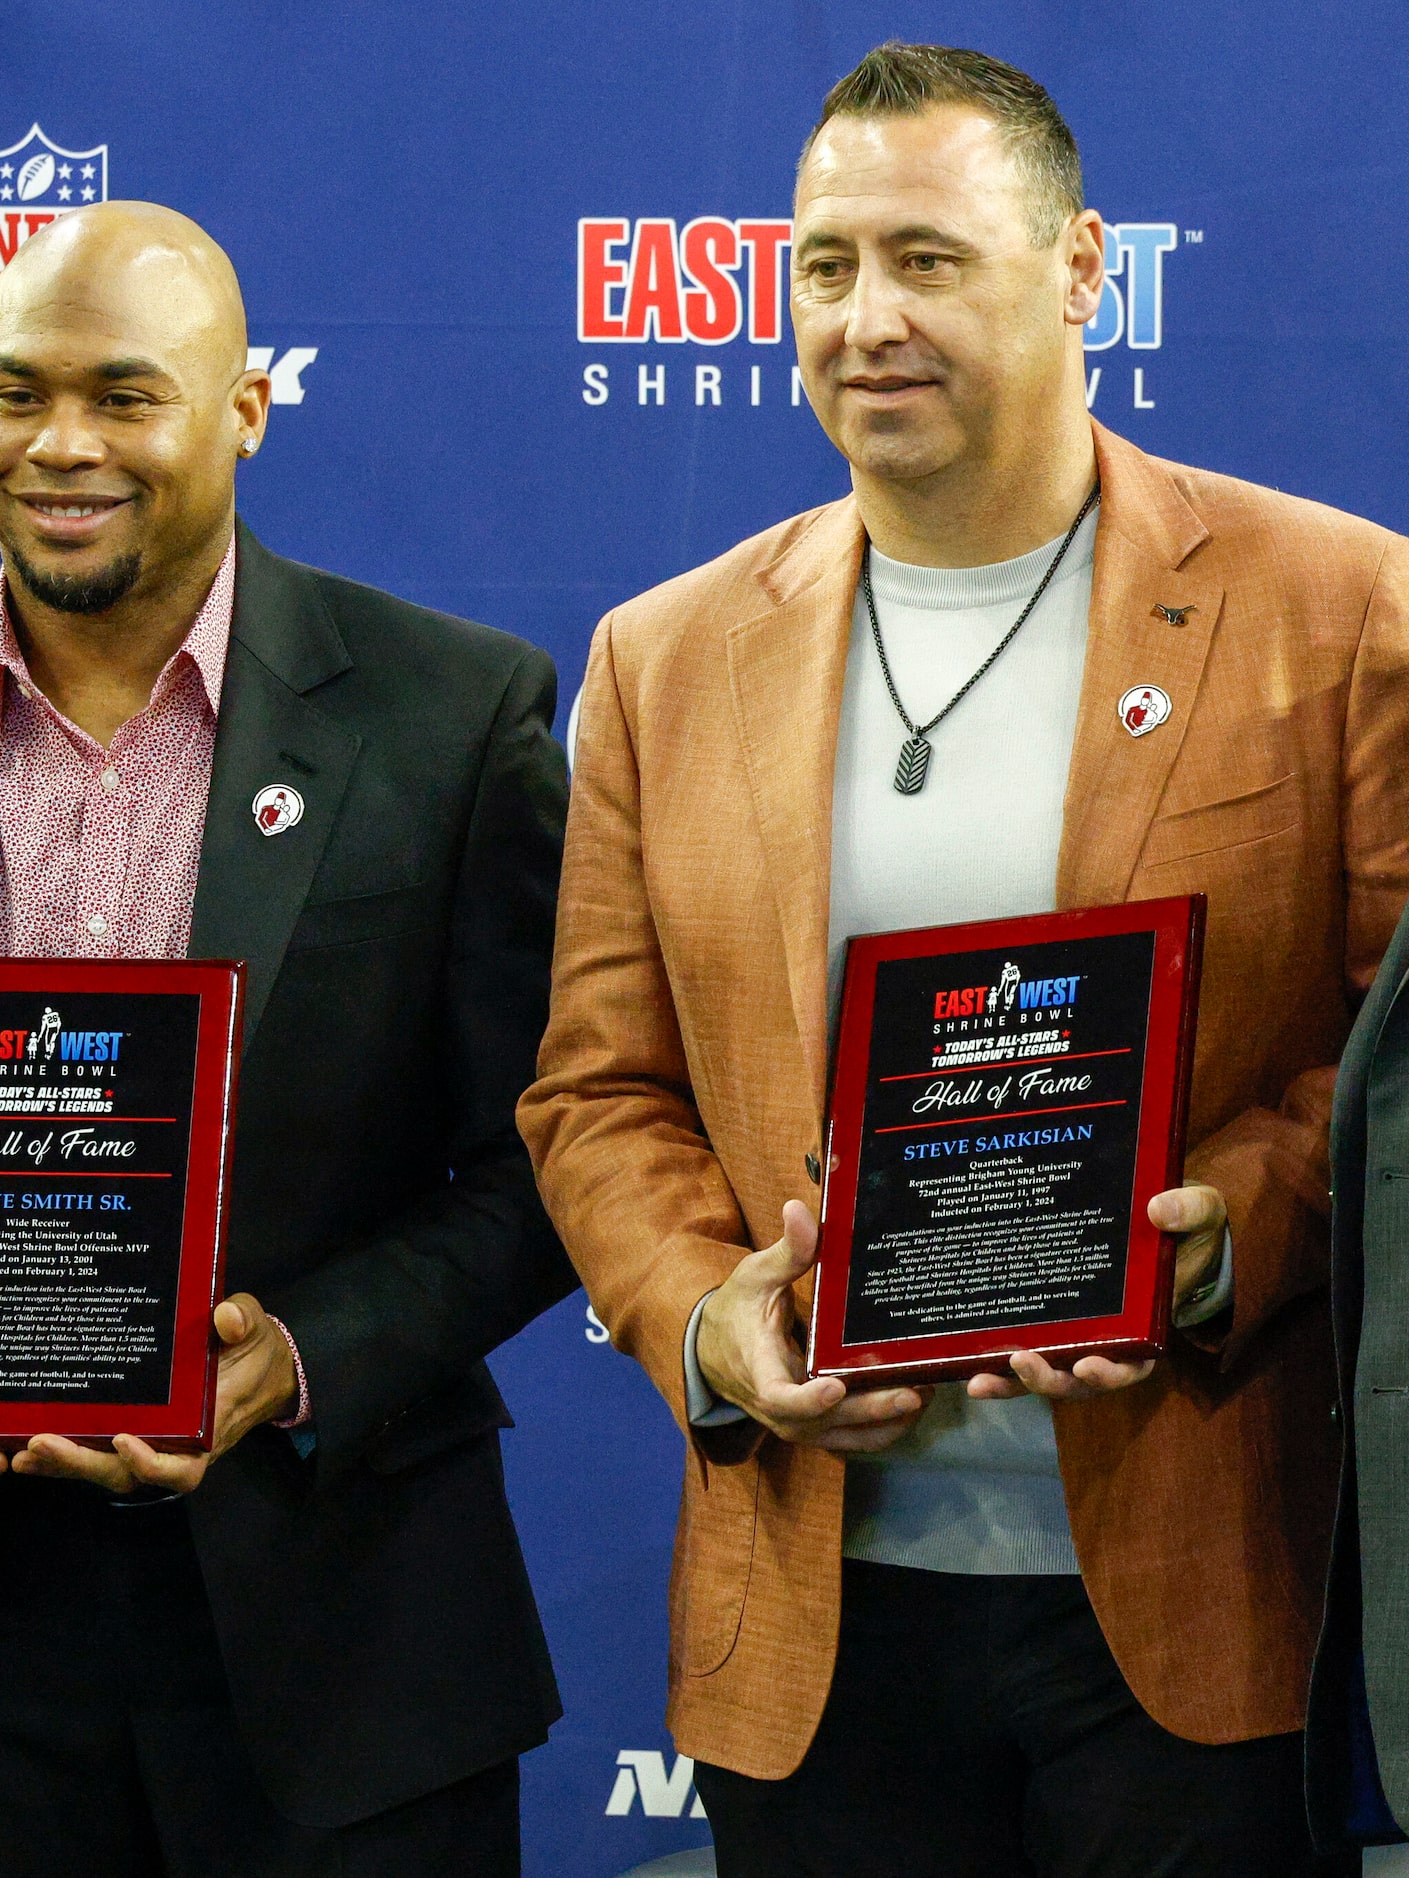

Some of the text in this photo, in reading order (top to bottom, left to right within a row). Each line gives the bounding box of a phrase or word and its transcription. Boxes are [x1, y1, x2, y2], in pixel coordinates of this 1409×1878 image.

[577, 217, 794, 345] EAST
[581, 363, 801, 407] SHRI
[1006, 968, 1017, 977] 26
[934, 976, 1080, 1019] EAST WEST
[47, 1015, 58, 1024] 26
[933, 1008, 1074, 1034] SHRINE BOWL
[60, 1032, 123, 1061] WEST
[945, 1030, 1060, 1054] TODAY'S ALL-STARS
[931, 1041, 1070, 1068] TOMORROW'S LEGENDS
[61, 1065, 117, 1077] BOWL
[37, 1087, 102, 1099] ALL-STARS
[912, 1067, 1093, 1113] Hall of Fame
[58, 1101, 113, 1113] LEGENDS
[27, 1131, 52, 1166] of
[61, 1127, 136, 1159] Fame
[904, 1124, 1093, 1160] STEVE SARKISIAN
[970, 1156, 1023, 1170] Quarterback
[909, 1161, 1082, 1188] Representing Brigham Young University
[919, 1172, 1070, 1197] 72nd annual East-West Shrine Bowl
[22, 1194, 92, 1209] SMITH
[937, 1196, 966, 1206] Played
[981, 1192, 1014, 1202] January
[1032, 1186, 1050, 1195] 1997
[931, 1206, 969, 1218] Inducted
[985, 1202, 1023, 1211] February
[1035, 1197, 1054, 1206] 2024
[6, 1219, 70, 1227] Wide Receiver
[18, 1231, 32, 1239] the
[35, 1231, 81, 1241] University
[84, 1231, 94, 1239] of
[96, 1232, 117, 1240] Utah
[23, 1243, 52, 1251] Shrine
[55, 1243, 77, 1251] Bowl
[80, 1244, 123, 1252] Offensive
[126, 1244, 149, 1252] MVP
[22, 1255, 56, 1265] January
[26, 1267, 65, 1277] February
[97, 1372, 124, 1380] serving
